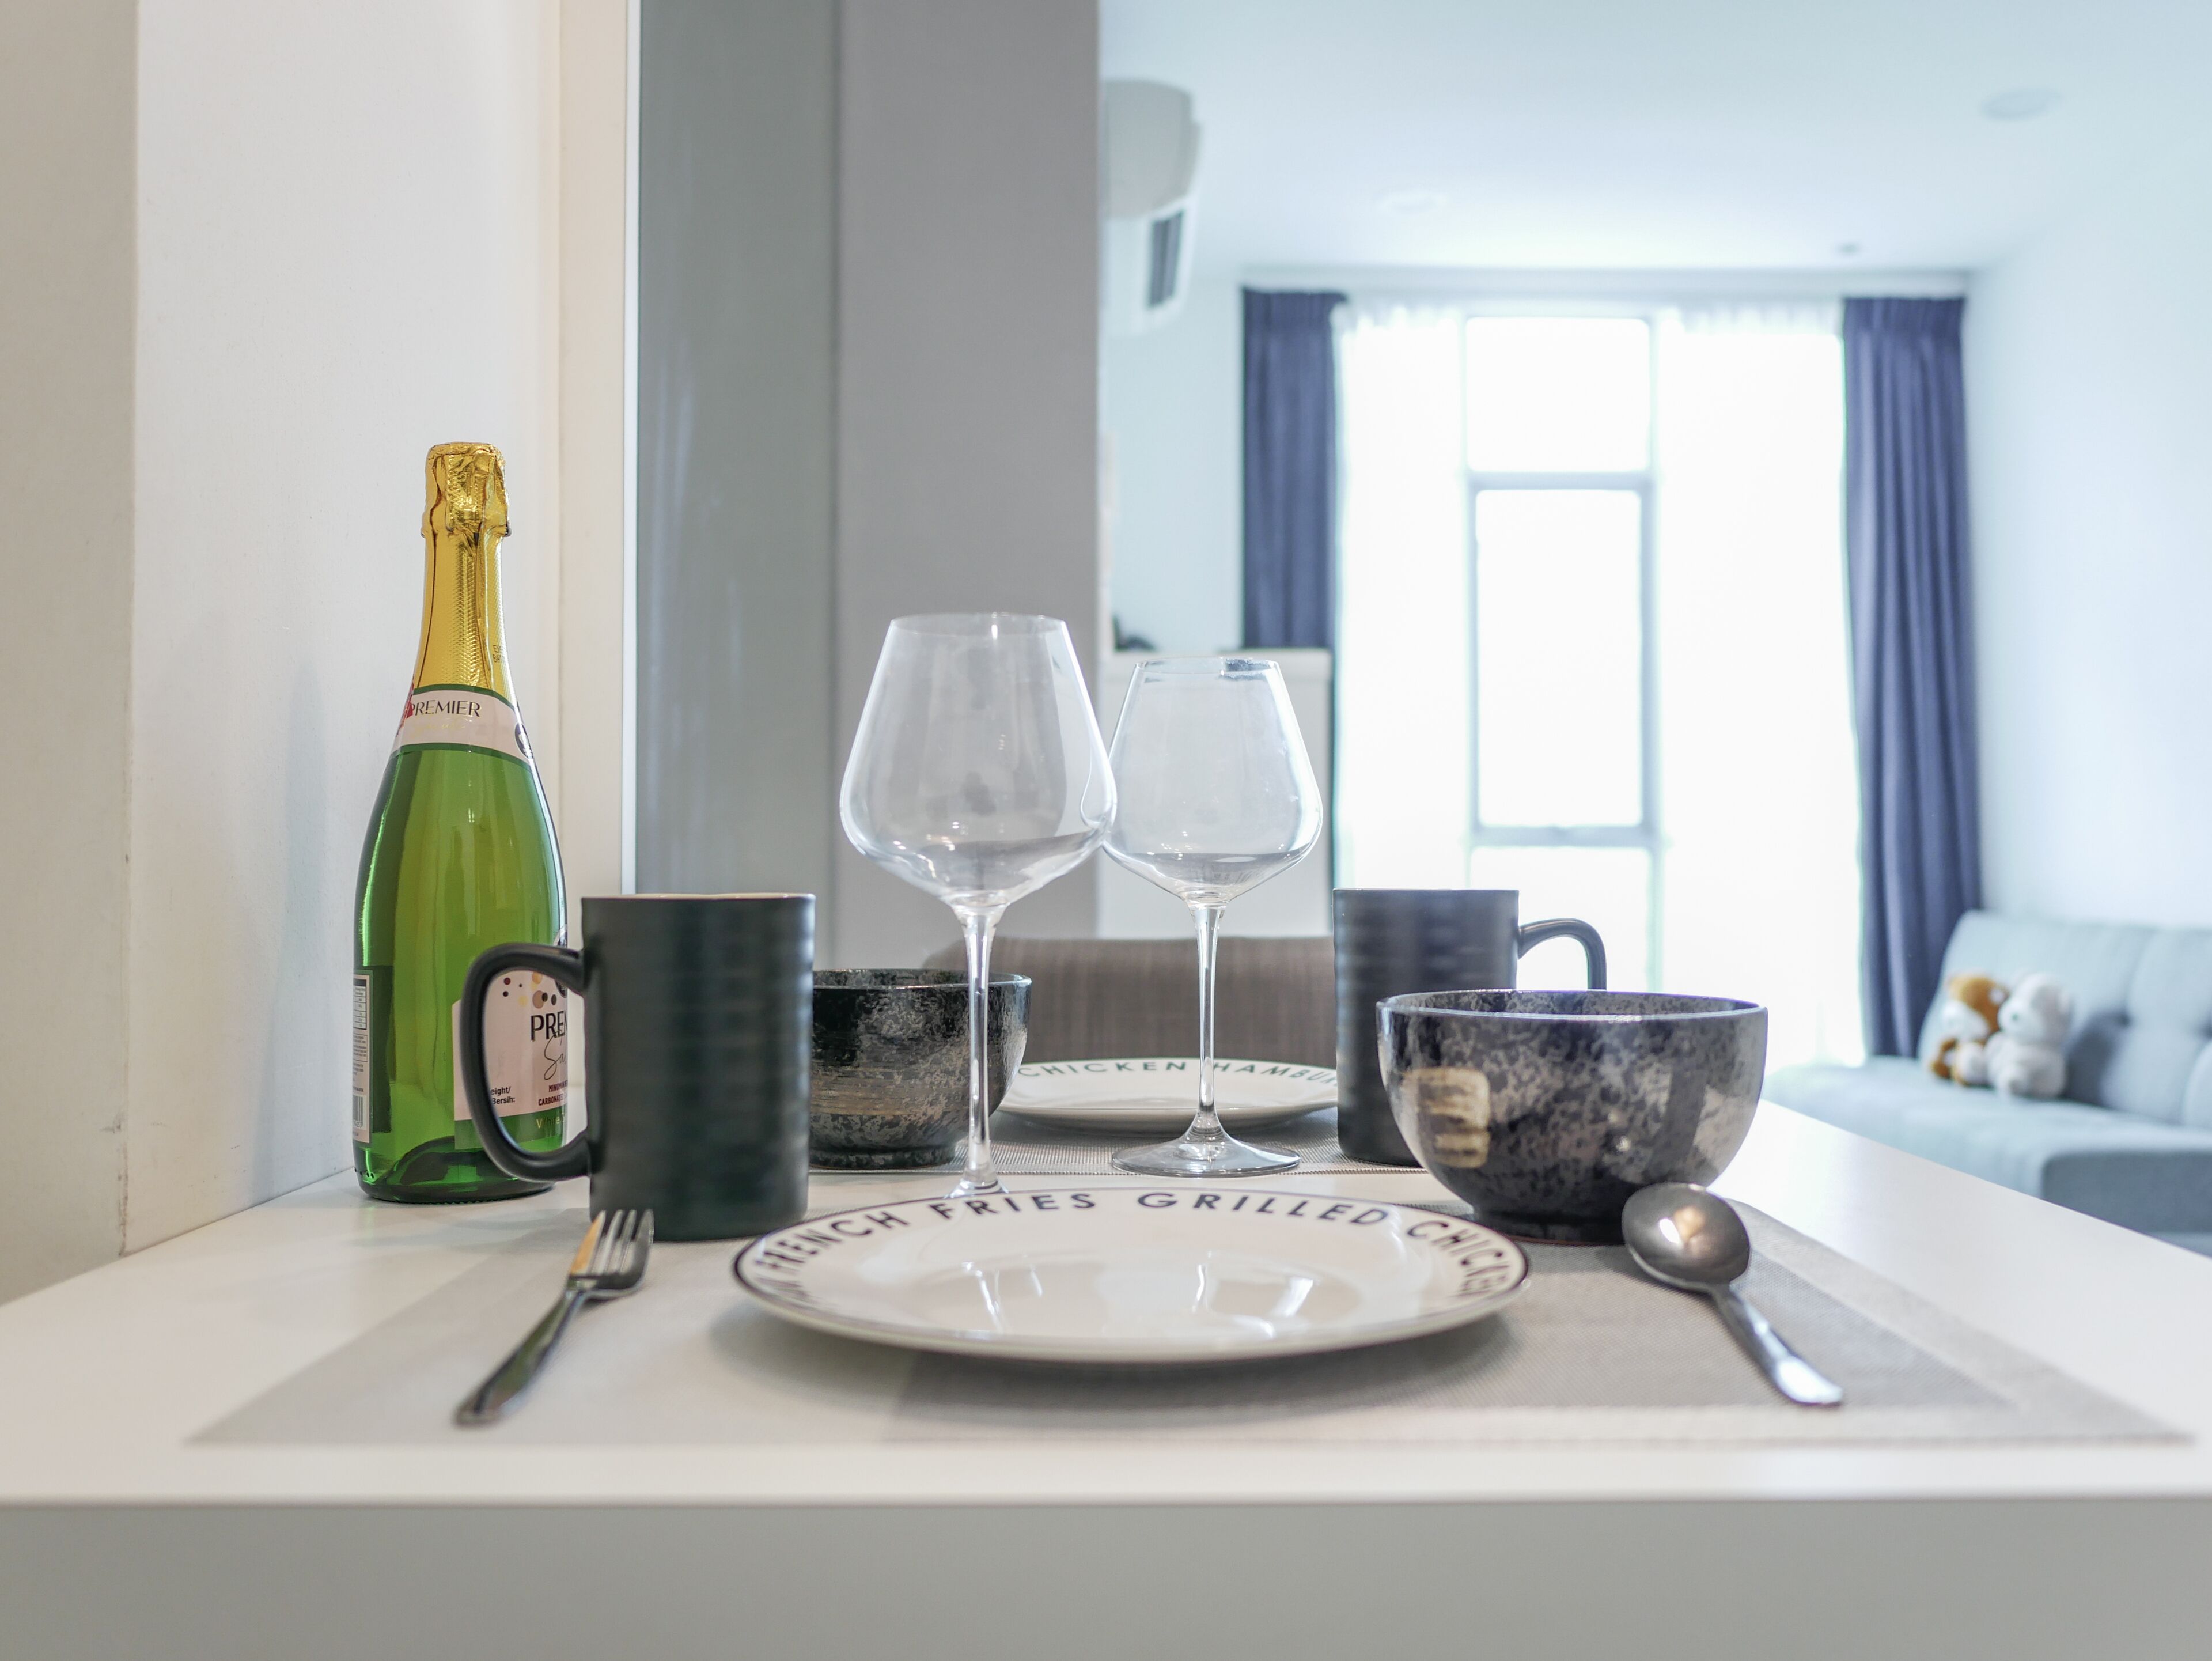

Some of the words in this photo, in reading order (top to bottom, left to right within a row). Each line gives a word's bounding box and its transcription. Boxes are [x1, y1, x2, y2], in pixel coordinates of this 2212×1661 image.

[1018, 1061, 1187, 1077] CHICKEN
[491, 1086, 511, 1096] eight/
[928, 1193, 1096, 1219] FRIES
[1137, 1193, 1389, 1225] GRILLED
